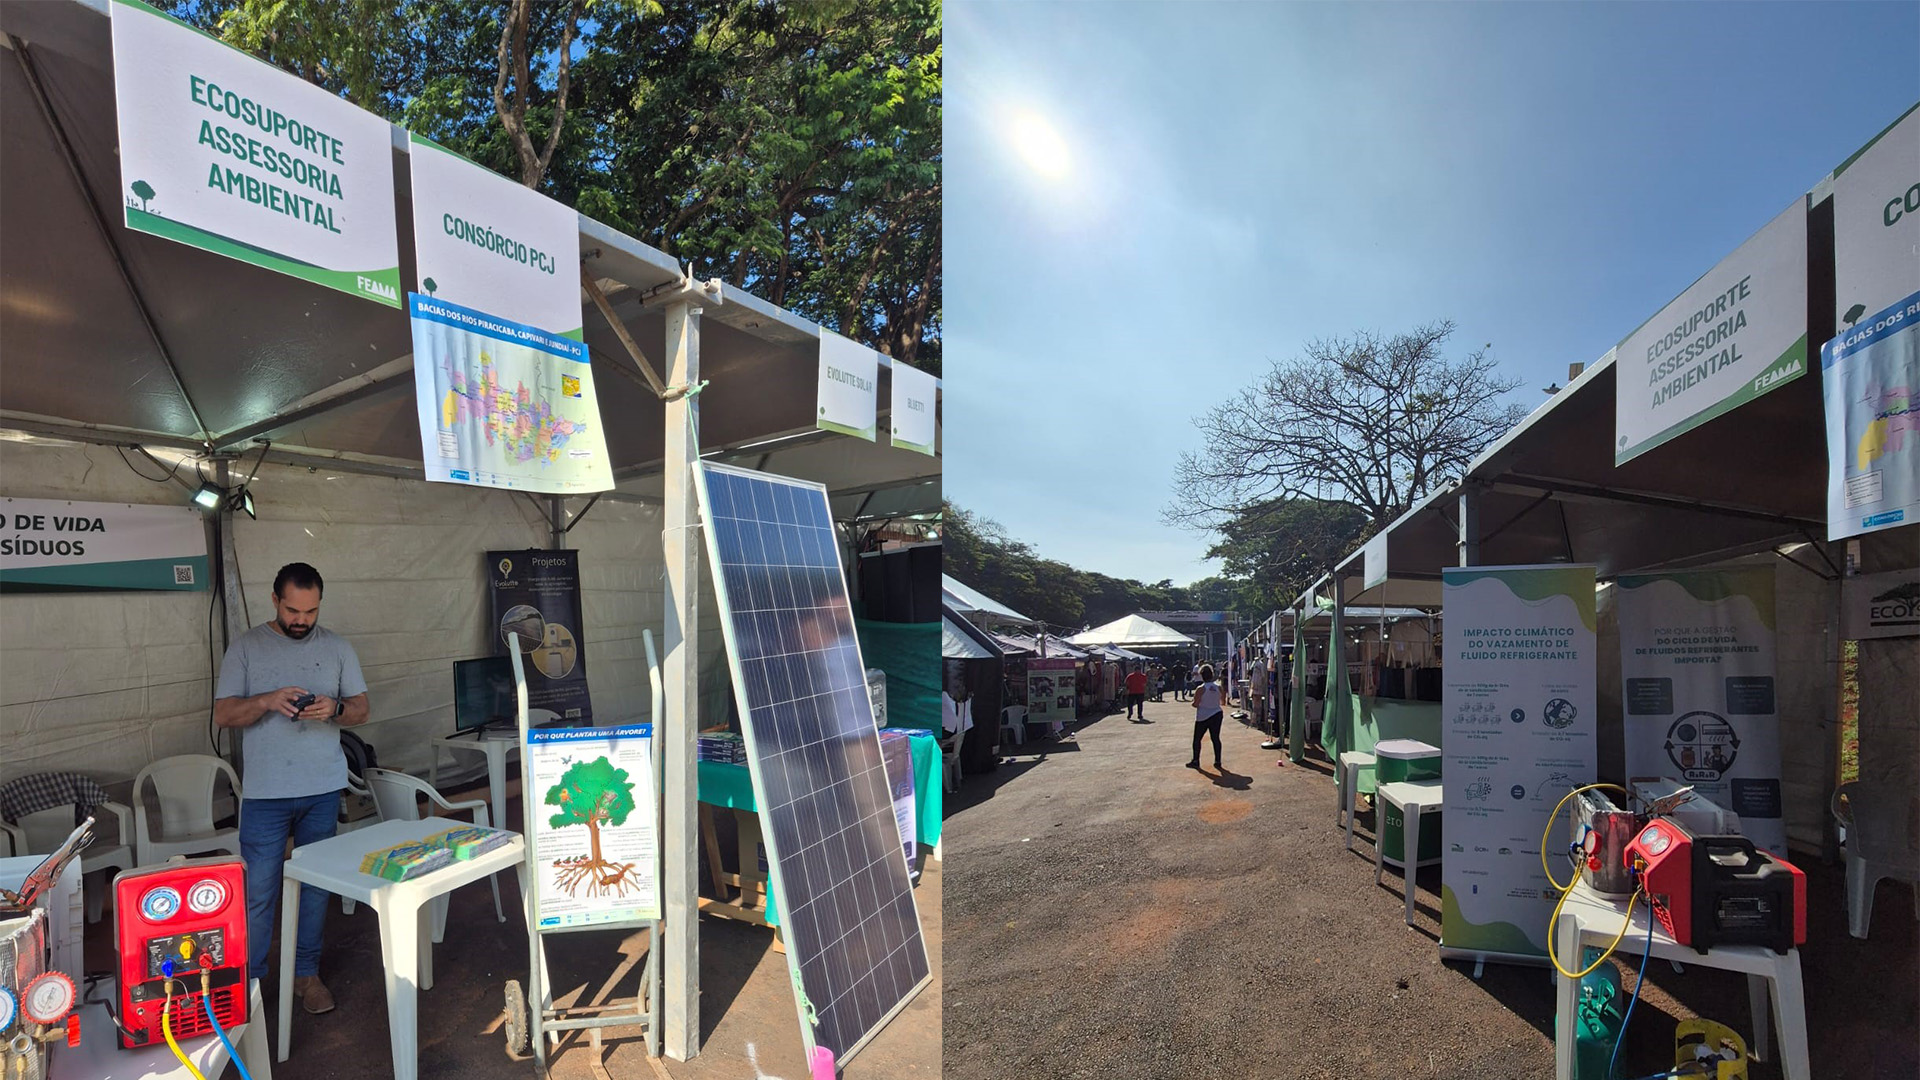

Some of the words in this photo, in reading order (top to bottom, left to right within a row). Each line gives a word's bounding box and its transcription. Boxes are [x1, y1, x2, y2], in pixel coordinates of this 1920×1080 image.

[190, 74, 344, 165] ECOSUPORTE
[199, 119, 343, 200] ASSESSORIA
[208, 163, 341, 234] AMBIENTAL
[443, 213, 527, 265] CONSÓRCIO
[530, 247, 555, 275] PCJ
[357, 275, 398, 300] FEAMA
[418, 302, 446, 316] BACIAS
[446, 309, 461, 321] DOS
[461, 314, 477, 326] RIOS
[478, 319, 517, 338] PIRACICABA,
[518, 330, 544, 345] CAPIVARI
[572, 346, 581, 356] PCJ
[1647, 275, 1751, 364] ECOSUPORTE
[1832, 326, 1873, 356] BACIAS
[1875, 310, 1904, 332] DOS
[1649, 309, 1747, 387] ASSESSORIA
[827, 366, 856, 387] EVOLUTTE
[856, 377, 872, 393] SOLAR
[1651, 343, 1743, 410] AMBIENTAL
[1754, 359, 1802, 392] FEAMA
[15, 514, 45, 530] DE
[53, 516, 106, 532] VIDA
[0, 534, 85, 556] SÍDUOS
[532, 558, 566, 568] Projetos
[1464, 628, 1512, 637] IMPACTO
[1514, 626, 1574, 636] CLIMÁTICO
[1468, 640, 1484, 648] DO
[1487, 640, 1552, 648] VAZAMENTO
[1556, 640, 1569, 648] DE
[1654, 628, 1672, 636] POR
[1674, 627, 1690, 636] QUE
[1461, 652, 1497, 660] FLUIDO
[1500, 651, 1578, 660] REFRIGERANTE
[1648, 647, 1686, 655] FLUIDOS
[1688, 646, 1760, 654] REFRIGERANTES
